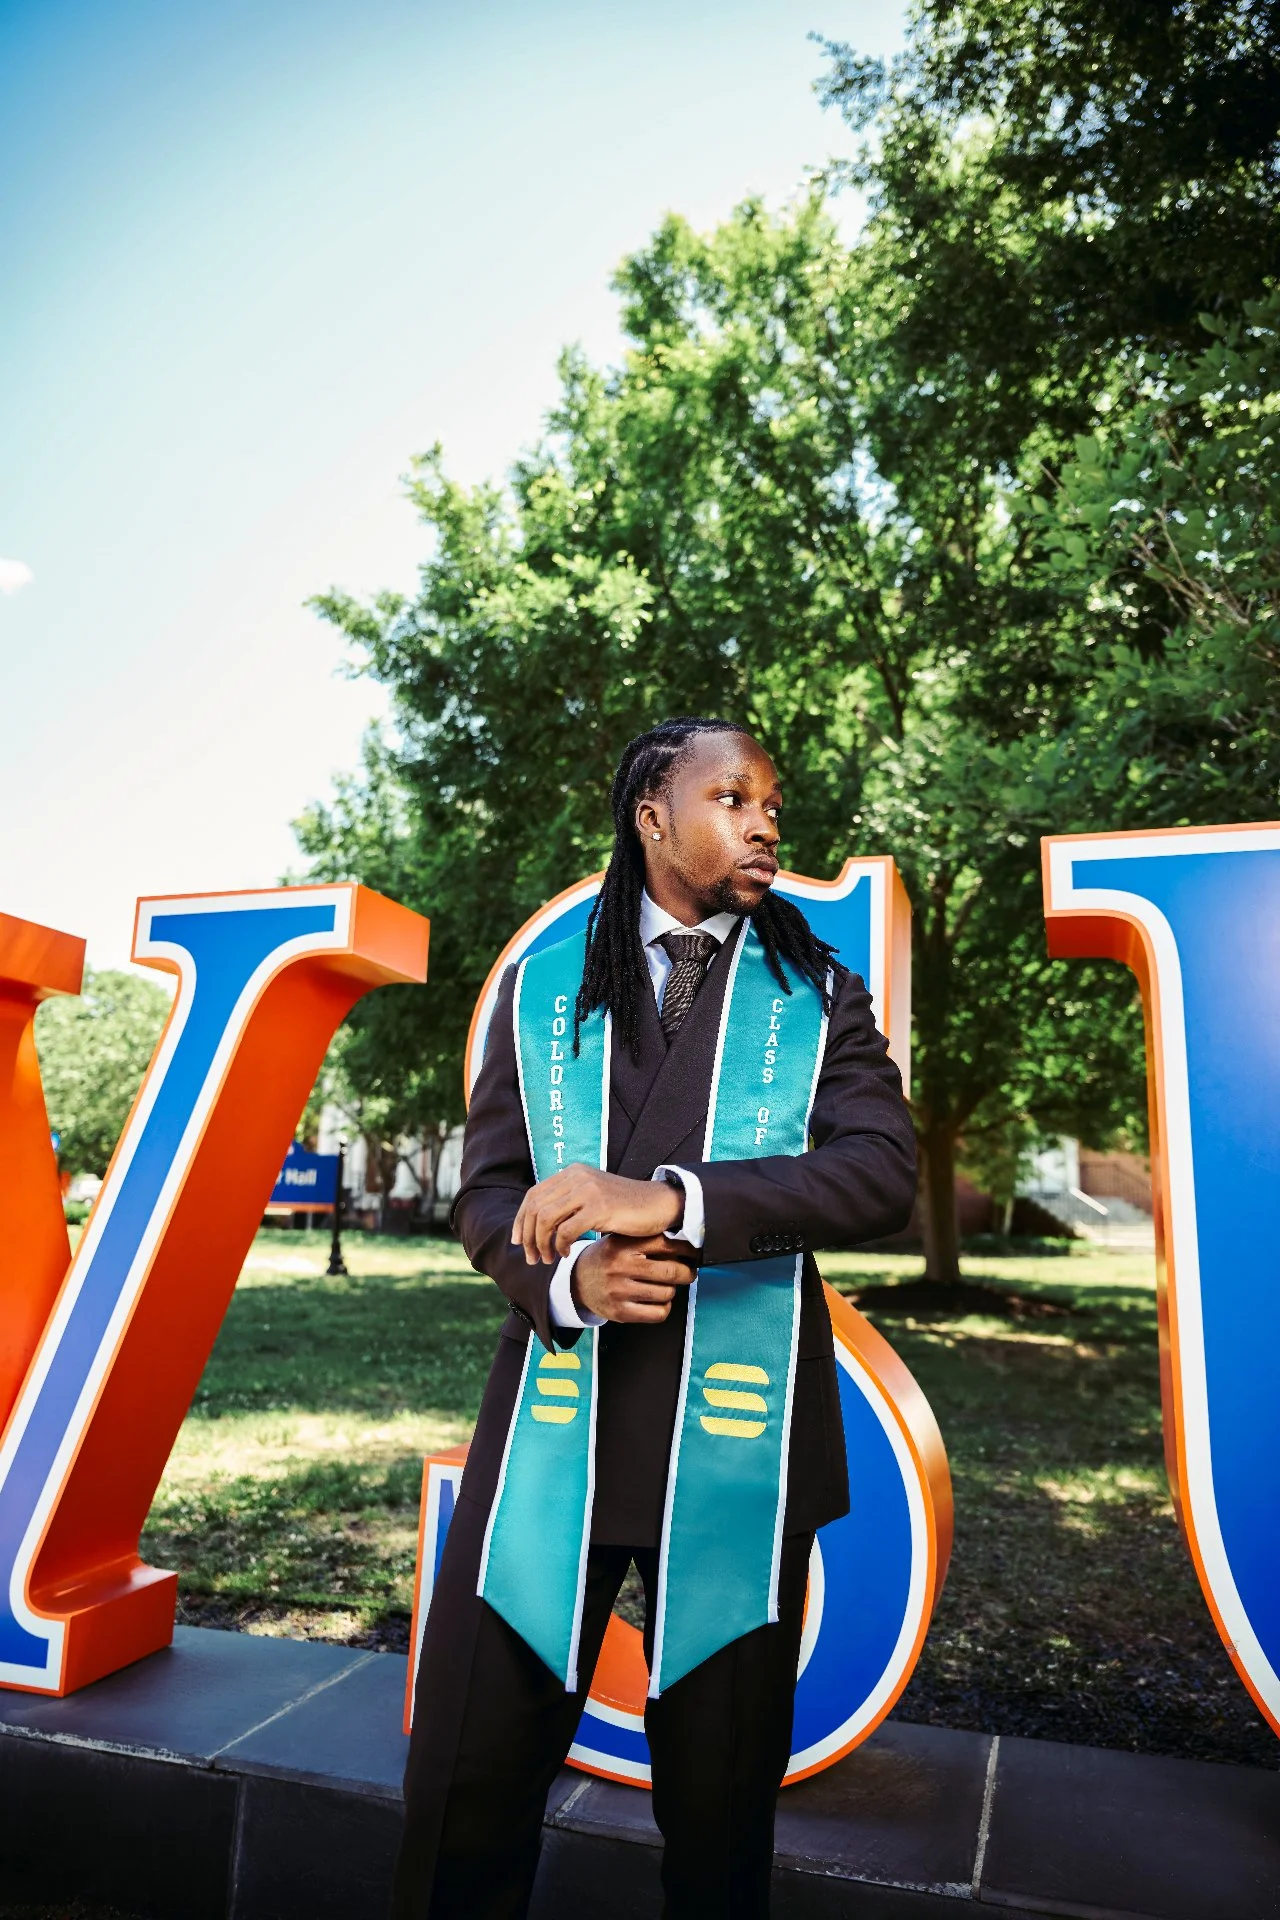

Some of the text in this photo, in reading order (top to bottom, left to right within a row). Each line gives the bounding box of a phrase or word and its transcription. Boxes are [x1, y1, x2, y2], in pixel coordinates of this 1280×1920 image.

[549, 995, 567, 1172] COLORST
[753, 998, 784, 1145] CLASS OF
